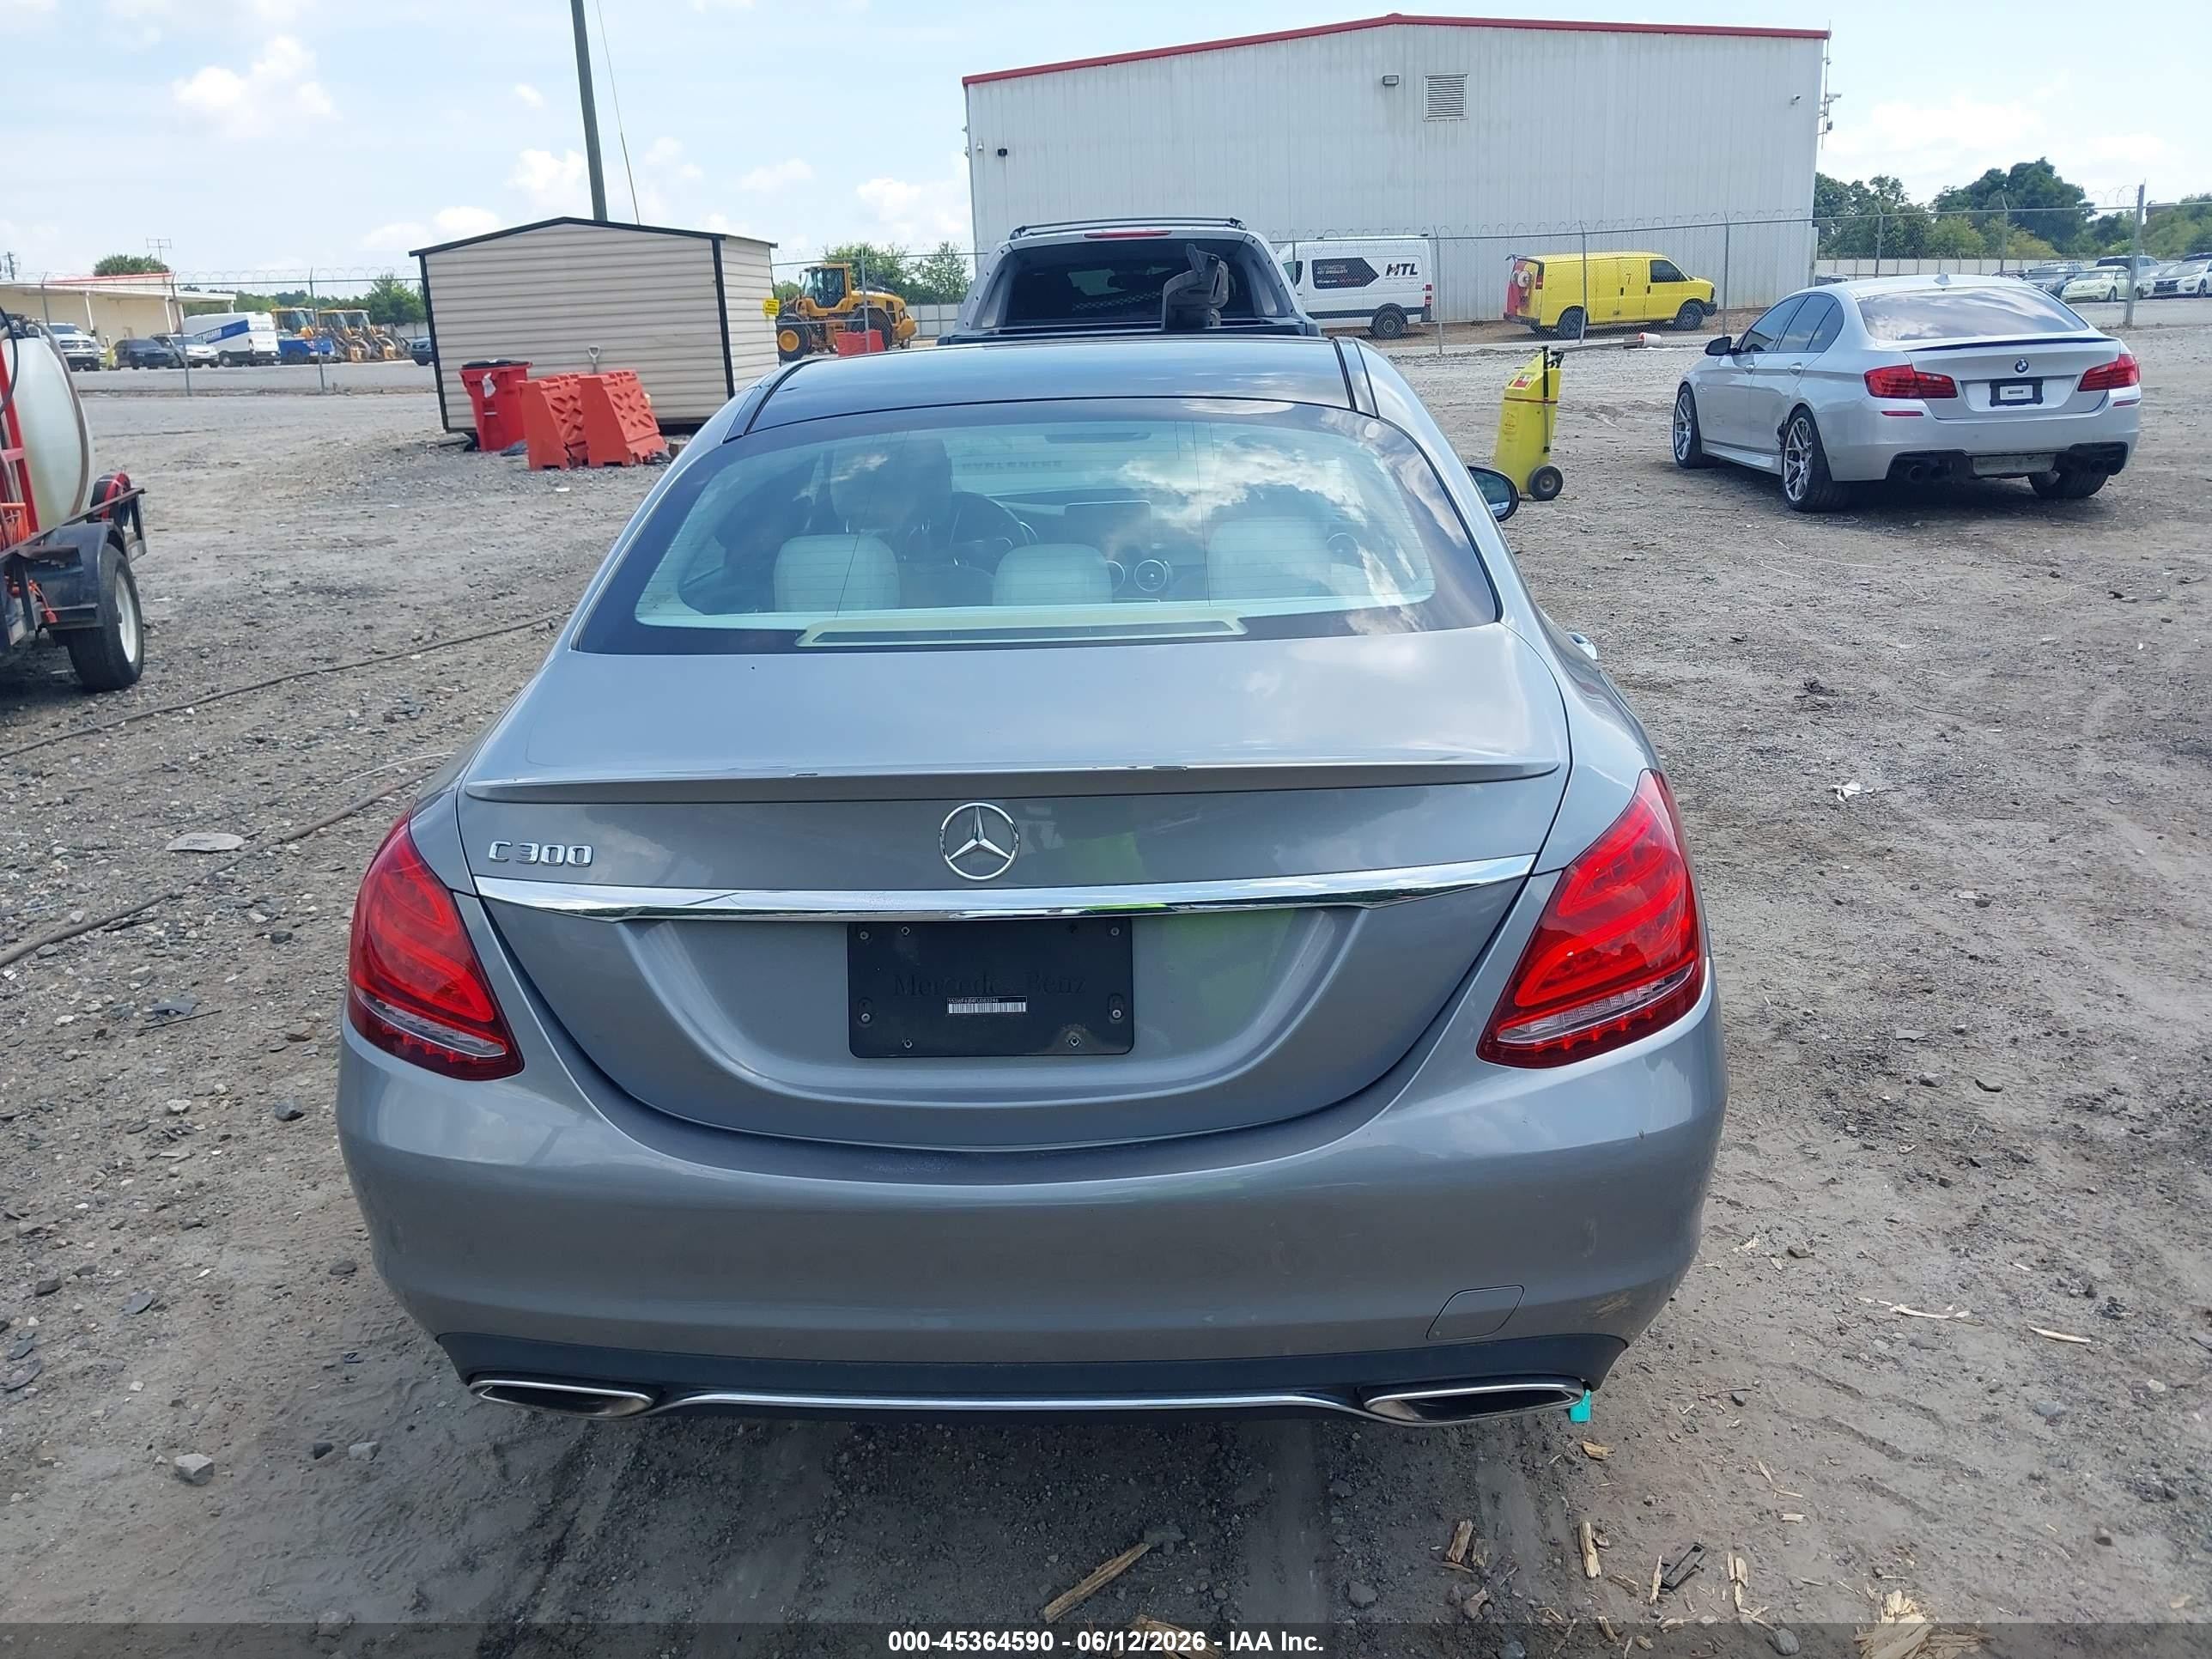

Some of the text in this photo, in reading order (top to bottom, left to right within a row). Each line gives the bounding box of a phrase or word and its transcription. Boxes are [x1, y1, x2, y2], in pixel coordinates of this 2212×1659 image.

[1385, 263, 1419, 276] HTL
[488, 840, 593, 867] C 300
